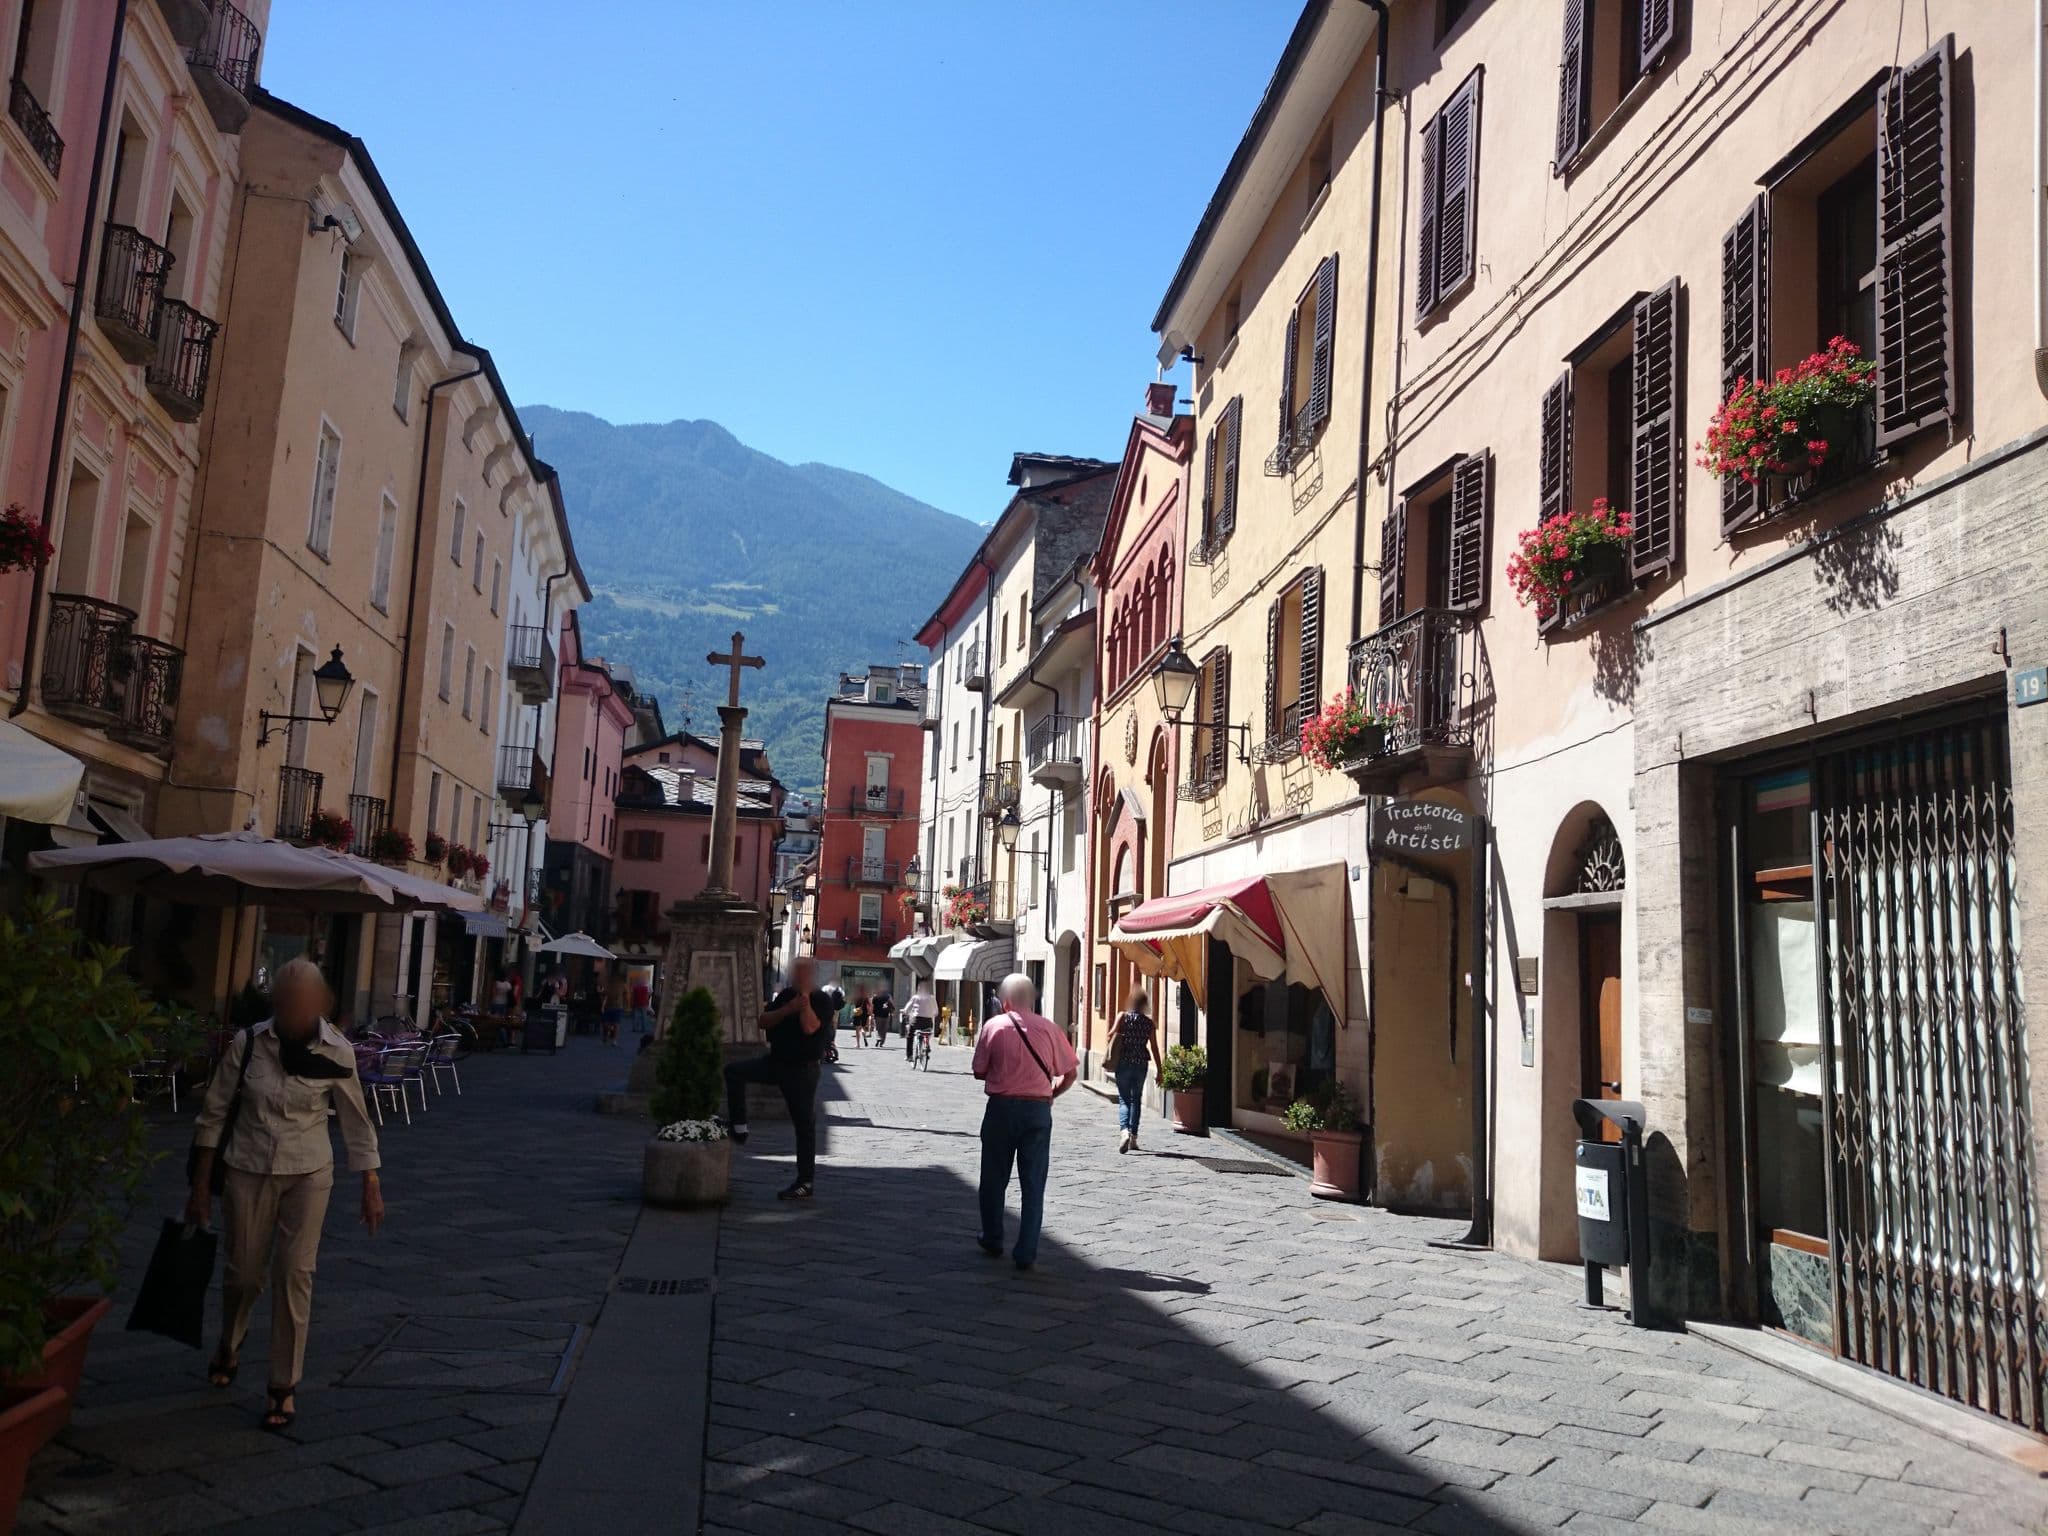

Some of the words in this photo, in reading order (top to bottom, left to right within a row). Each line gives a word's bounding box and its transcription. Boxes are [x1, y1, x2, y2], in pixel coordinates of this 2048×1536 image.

[2021, 677, 2040, 697] 19
[1384, 804, 1465, 824] Trattoria
[1385, 828, 1461, 850] Artisti
